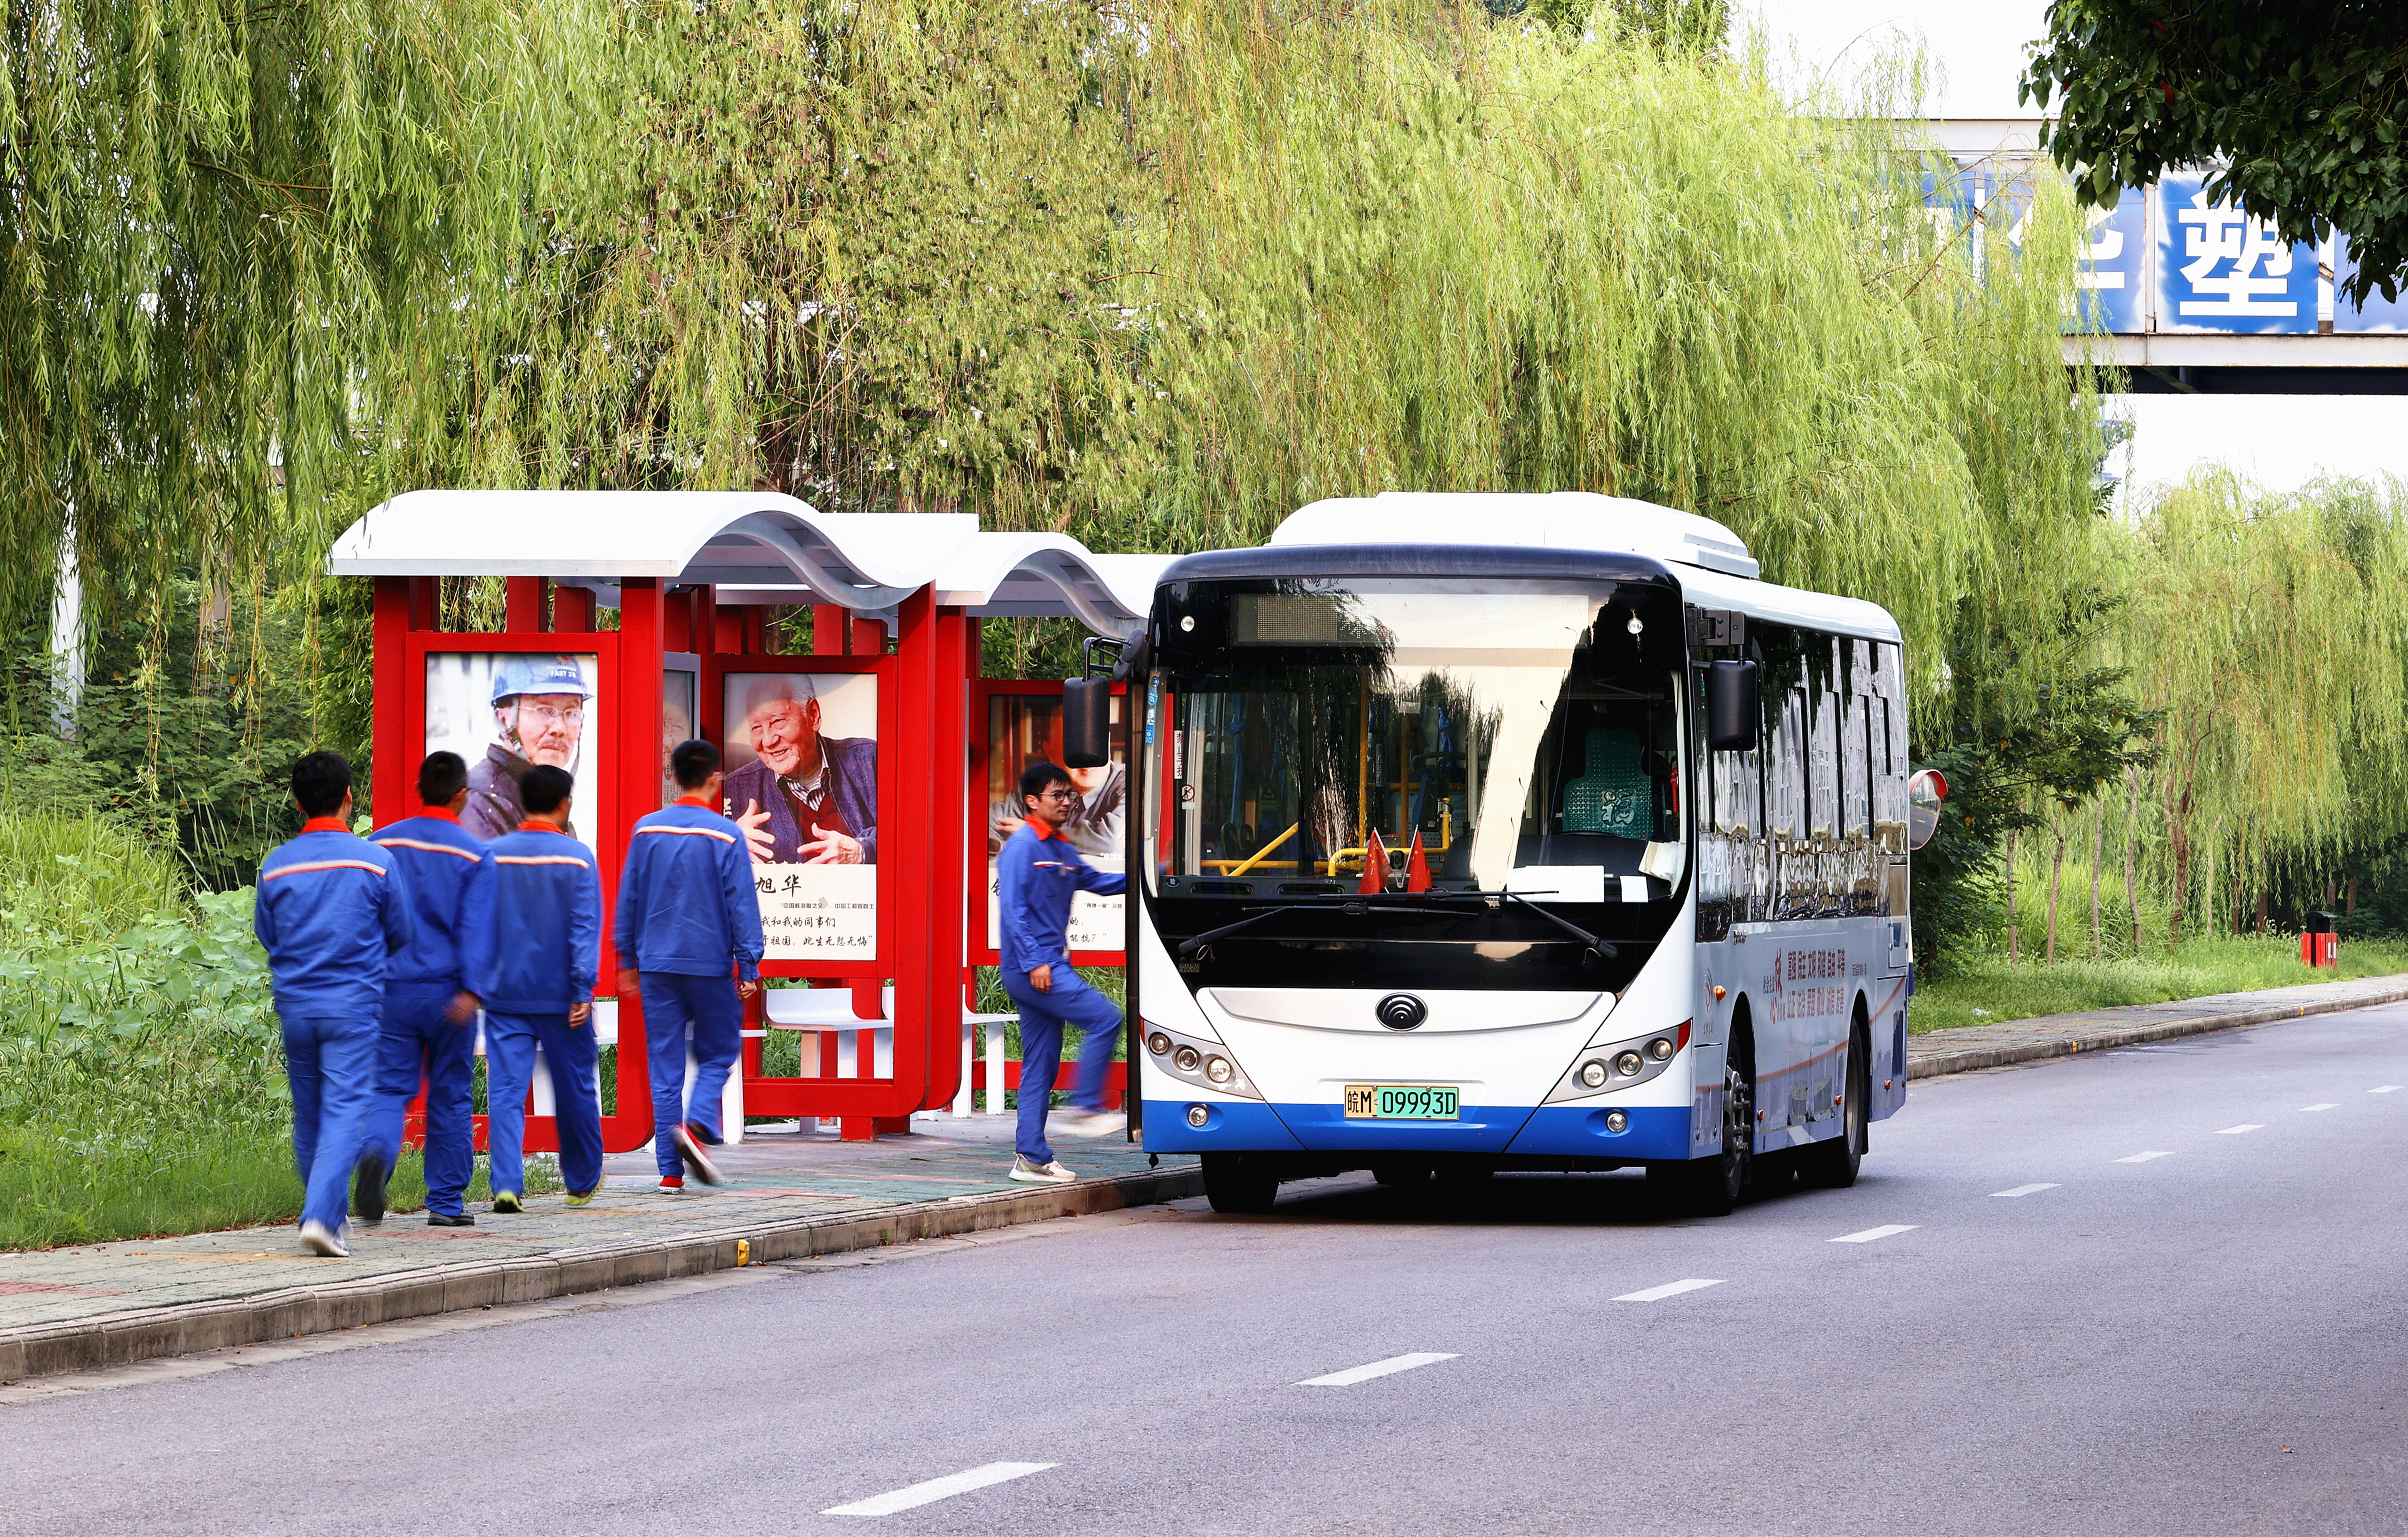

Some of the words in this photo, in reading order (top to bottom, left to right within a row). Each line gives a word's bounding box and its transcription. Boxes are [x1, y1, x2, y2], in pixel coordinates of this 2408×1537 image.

[755, 874, 801, 897] 旭华
[761, 916, 836, 928] 我和我的同事们
[1347, 1091, 1372, 1113] 皖M
[1383, 1091, 1456, 1114] 09993D
